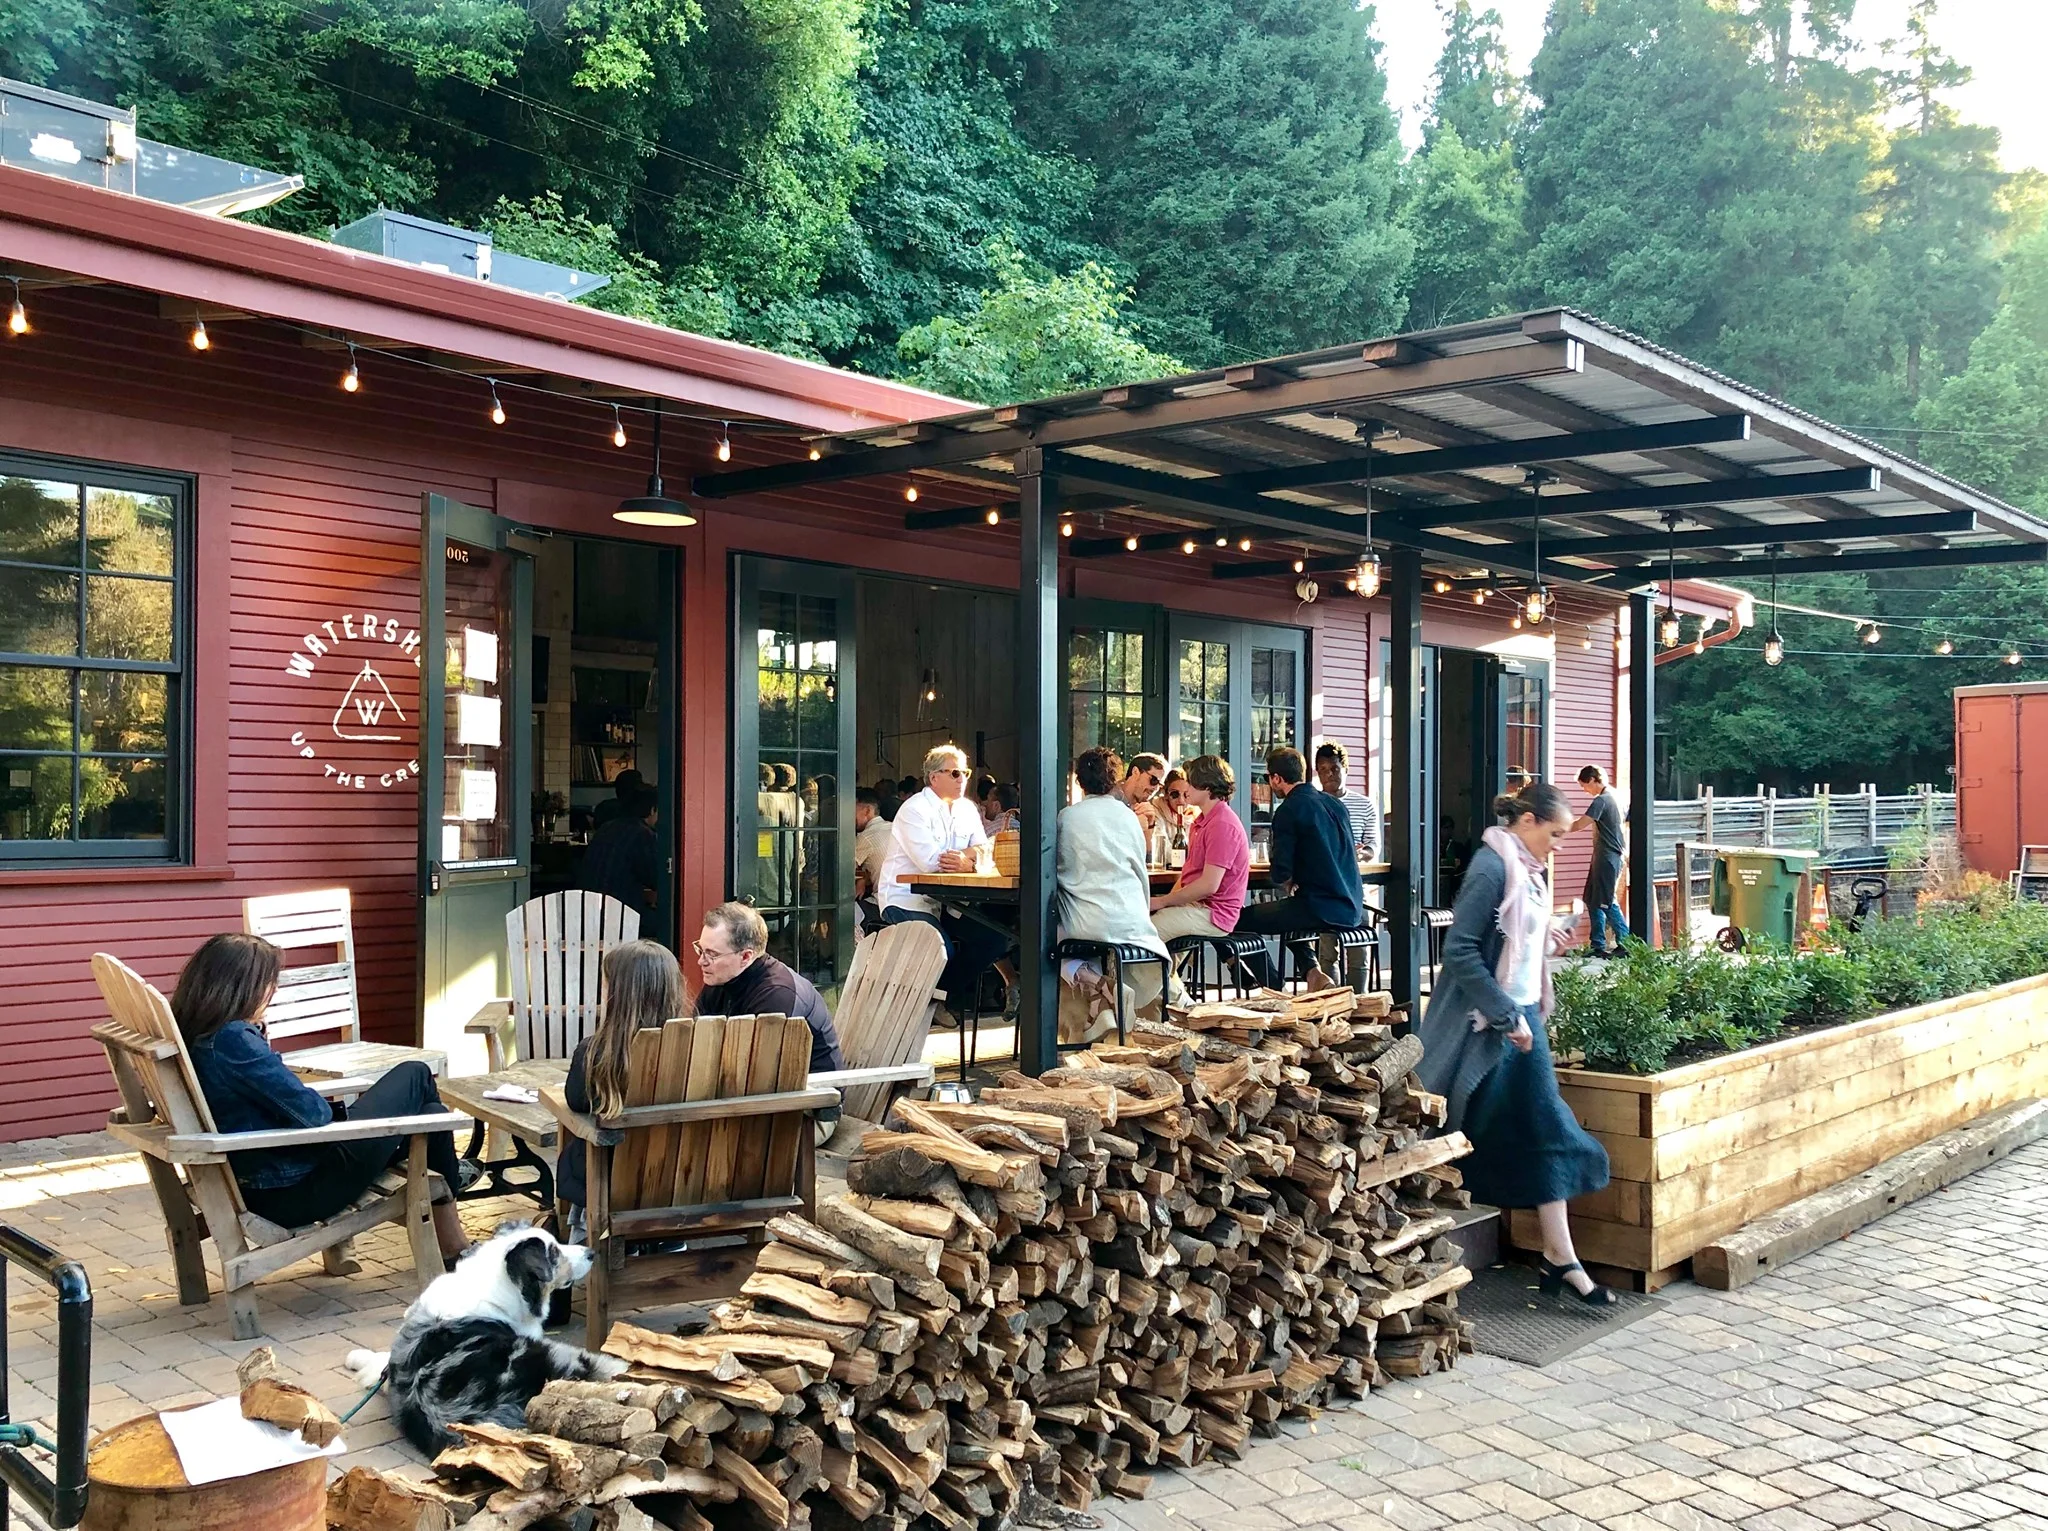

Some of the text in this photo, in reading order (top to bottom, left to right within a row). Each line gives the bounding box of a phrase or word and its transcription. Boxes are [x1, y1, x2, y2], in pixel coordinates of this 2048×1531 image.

[354, 698, 385, 725] W
[291, 731, 420, 789] UP THE CRE
